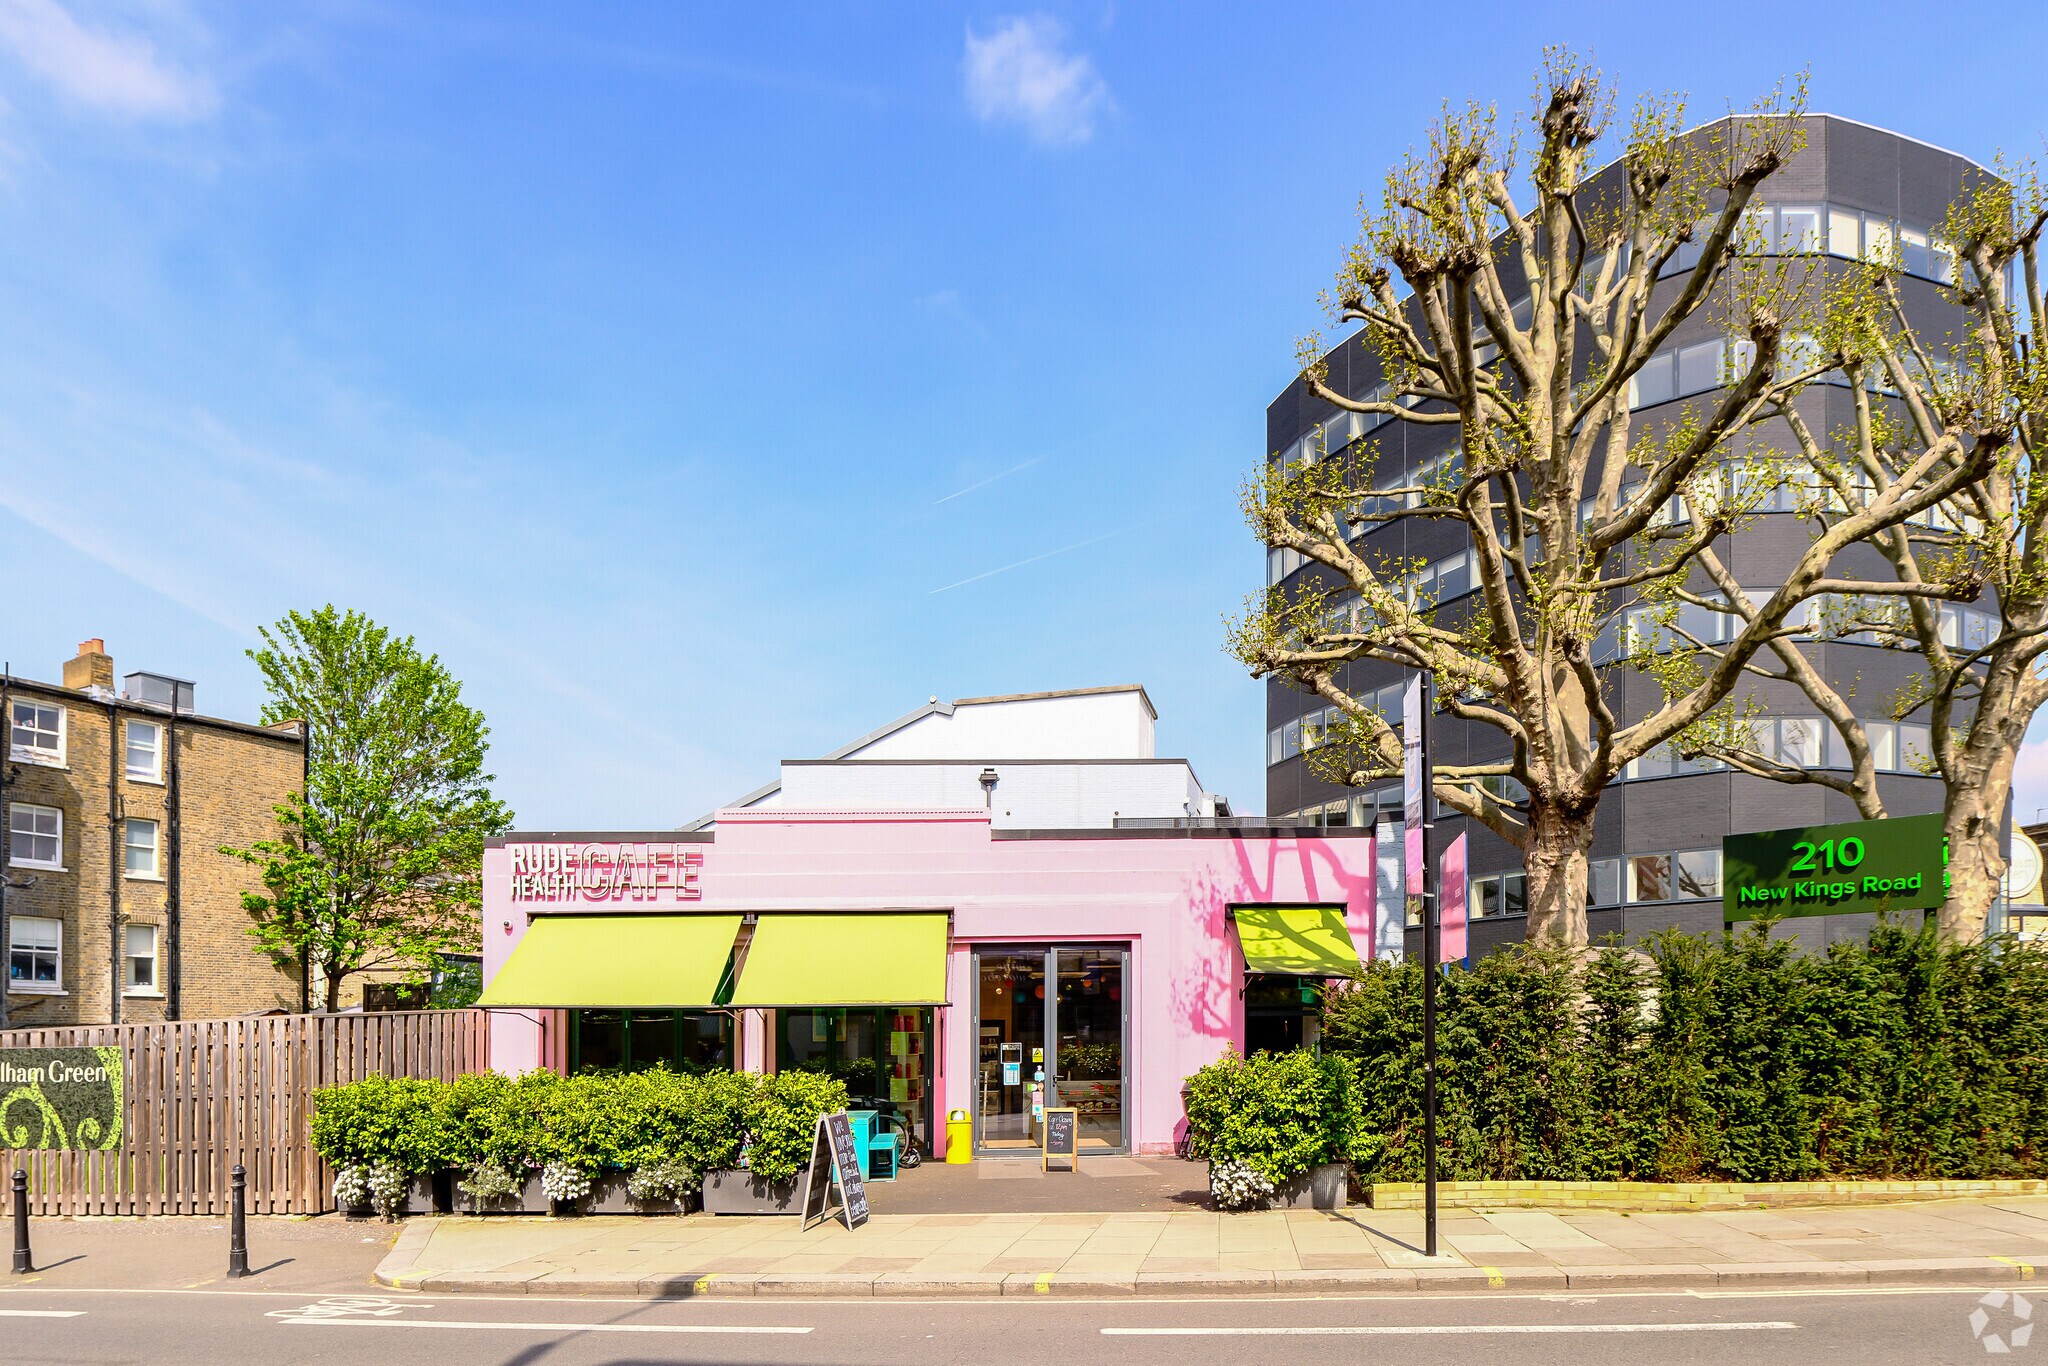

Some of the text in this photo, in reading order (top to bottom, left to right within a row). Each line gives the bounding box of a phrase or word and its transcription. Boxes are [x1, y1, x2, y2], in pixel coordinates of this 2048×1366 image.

[510, 844, 576, 873] RUDE
[1791, 836, 1865, 871] 210
[580, 842, 702, 898] CAFE
[510, 874, 576, 898] HEALTH
[1740, 872, 1922, 902] New Kings Road
[48, 1060, 107, 1083] Green
